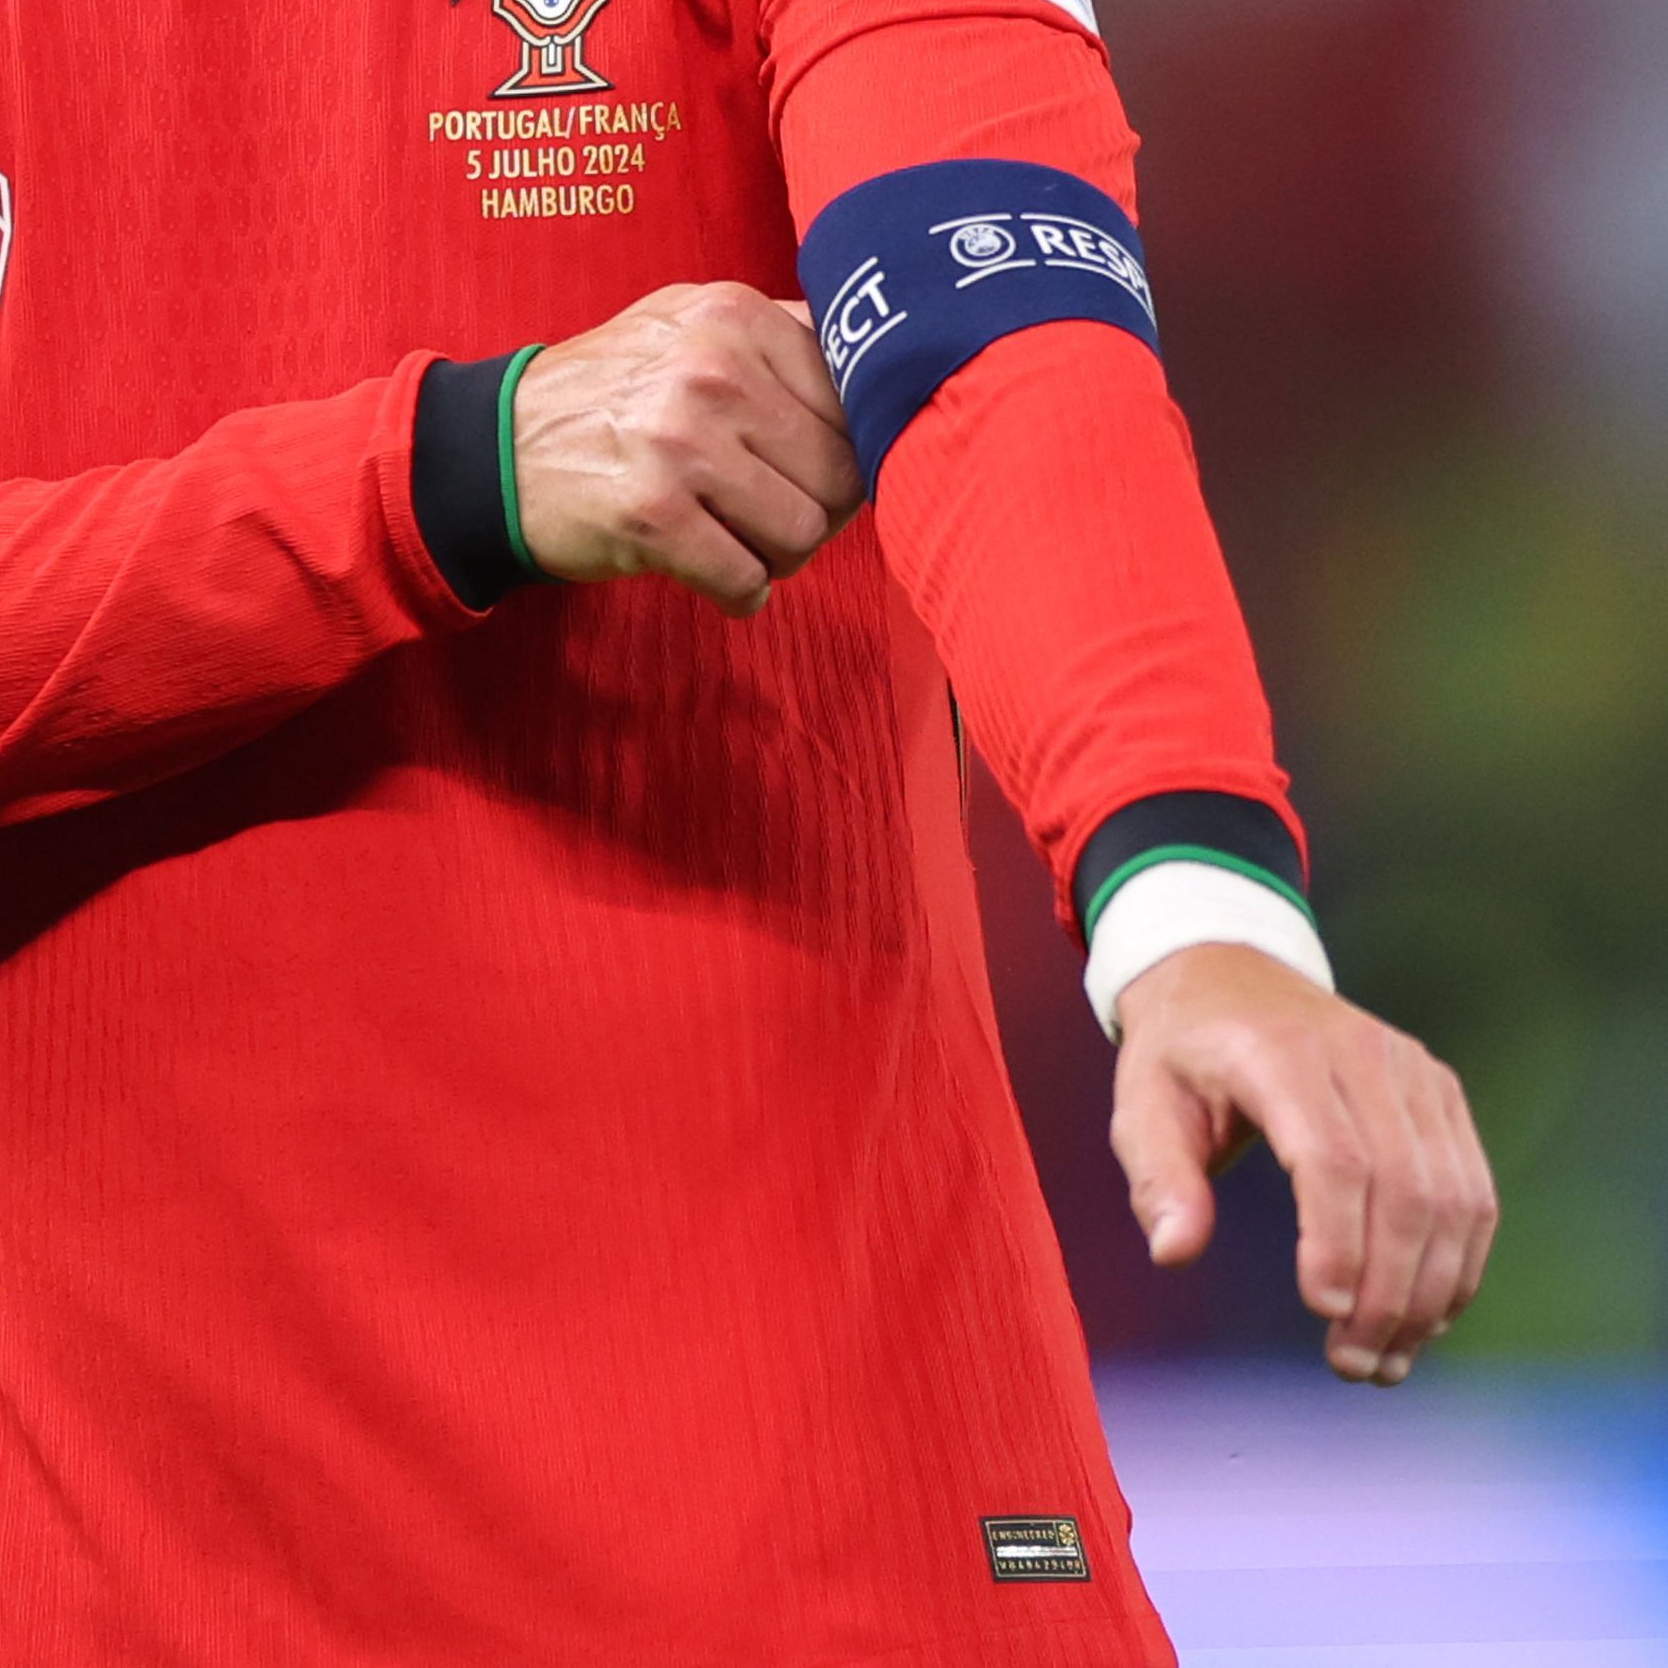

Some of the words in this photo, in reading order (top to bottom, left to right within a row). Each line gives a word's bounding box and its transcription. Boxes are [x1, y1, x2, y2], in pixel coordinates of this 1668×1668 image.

[429, 101, 681, 142] PORTUGAL/FRANÇA
[466, 149, 481, 179] 5
[488, 147, 576, 179] JULHO
[581, 143, 646, 175] 2024
[481, 184, 635, 219] HAMBURGO
[825, 271, 890, 371] ECT
